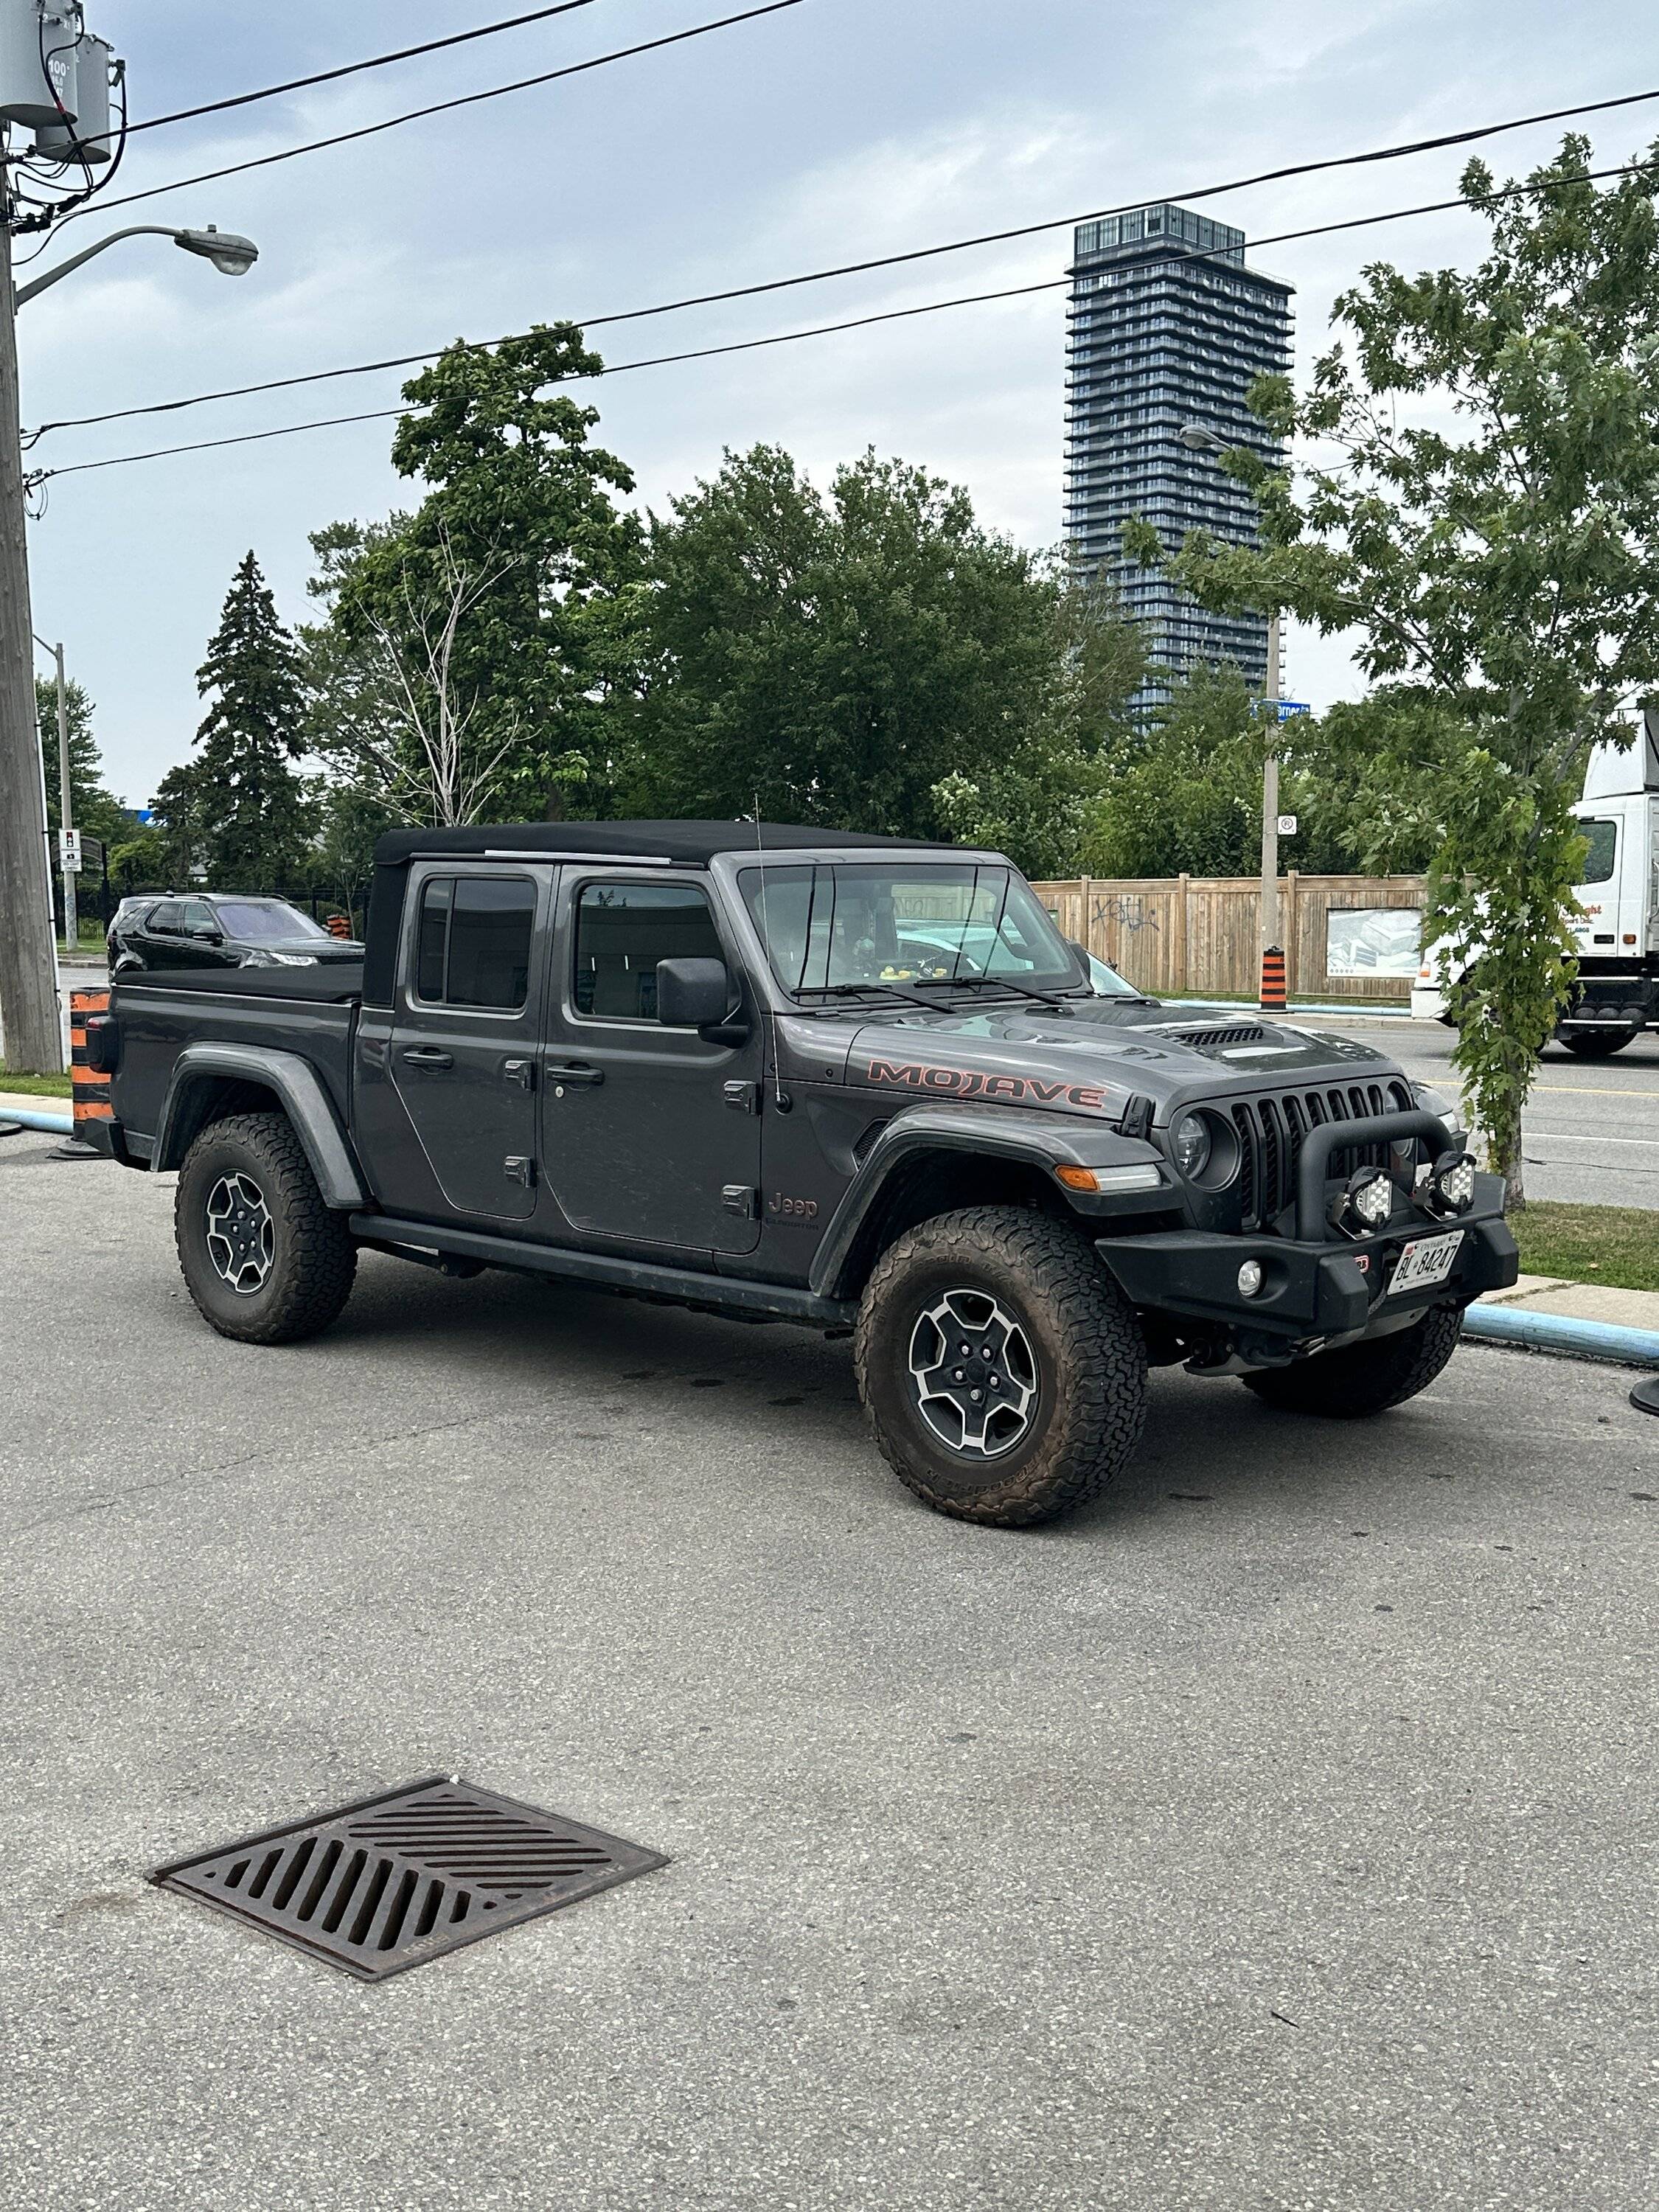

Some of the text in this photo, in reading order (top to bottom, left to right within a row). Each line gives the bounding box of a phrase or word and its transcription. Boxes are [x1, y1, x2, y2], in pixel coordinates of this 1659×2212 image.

[868, 1060, 1106, 1109] MOJAVE
[768, 1192, 818, 1220] Jeep
[1416, 1244, 1458, 1276] 84247
